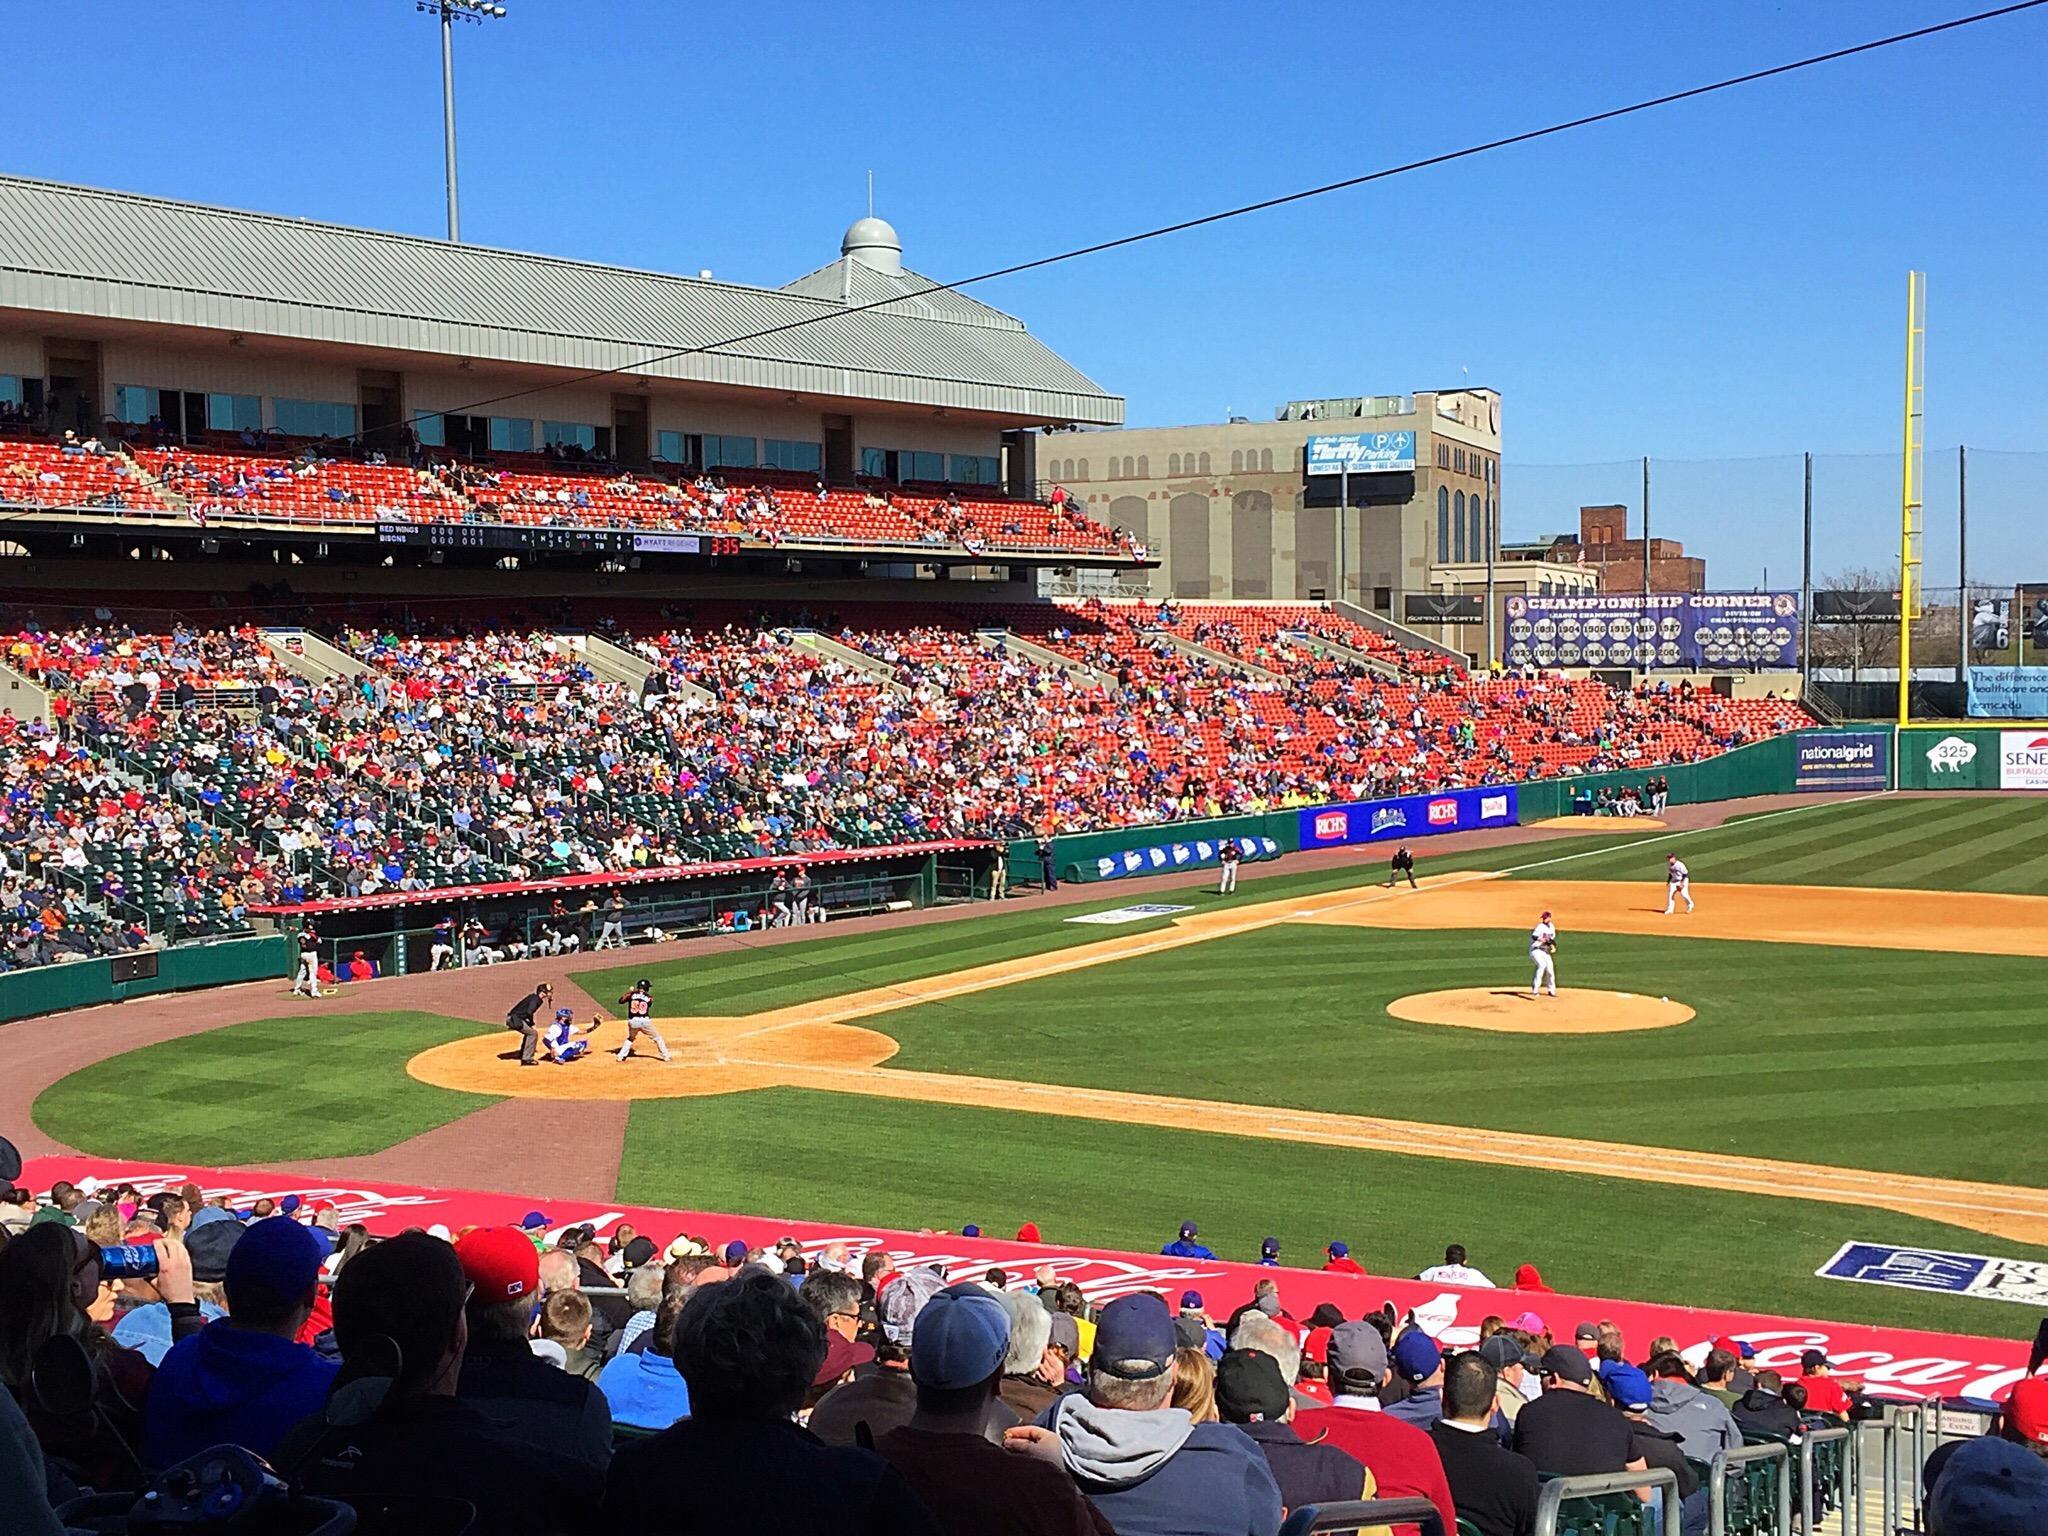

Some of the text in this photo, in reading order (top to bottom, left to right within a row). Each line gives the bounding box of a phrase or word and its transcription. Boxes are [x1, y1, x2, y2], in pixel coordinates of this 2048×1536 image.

[379, 525, 419, 534] RED WINGS
[379, 534, 407, 542] BISONS
[711, 537, 739, 554] 3:35
[1528, 596, 1772, 610] CHAMPIONSHIP CORNER
[1610, 625, 1631, 633] 1915
[1996, 628, 2009, 648] 6
[1974, 671, 2047, 681] The difference
[1973, 684, 2028, 693] healthcare
[1801, 742, 1873, 761] nationalgrid
[1939, 746, 1968, 758] 325
[1429, 803, 1457, 820] RICH'S
[1316, 816, 1347, 834] RICH'S
